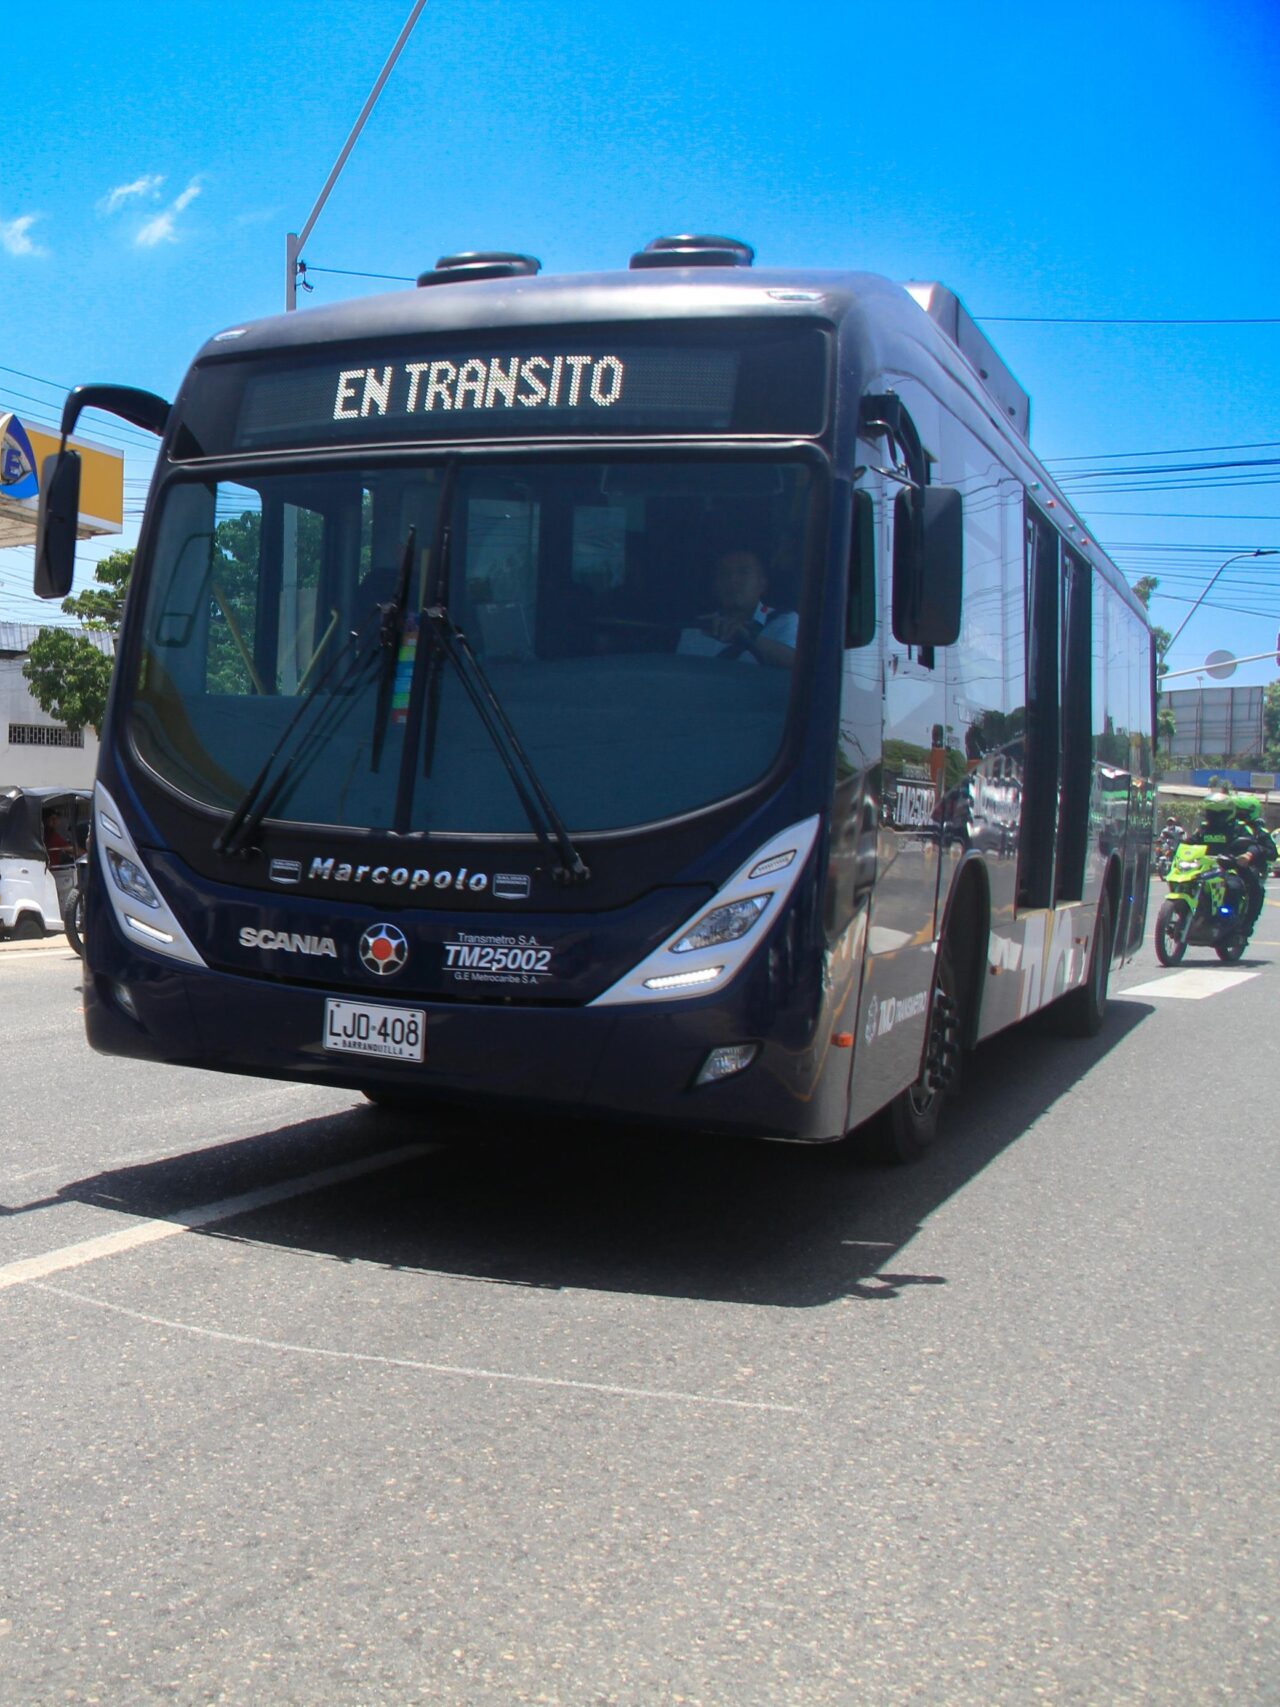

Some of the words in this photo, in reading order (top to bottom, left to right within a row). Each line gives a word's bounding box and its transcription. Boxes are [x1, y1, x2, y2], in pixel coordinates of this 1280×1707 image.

[333, 366, 393, 421] EN
[405, 355, 624, 413] TRANSITO
[307, 857, 489, 892] Marcopolo
[238, 926, 338, 958] SCANIA
[458, 932, 517, 946] Transmetro
[518, 935, 540, 946] S.A.
[445, 945, 552, 971] TM25002
[471, 972, 521, 984] Metrocaribe
[342, 1039, 404, 1056] BARRANQUILLA
